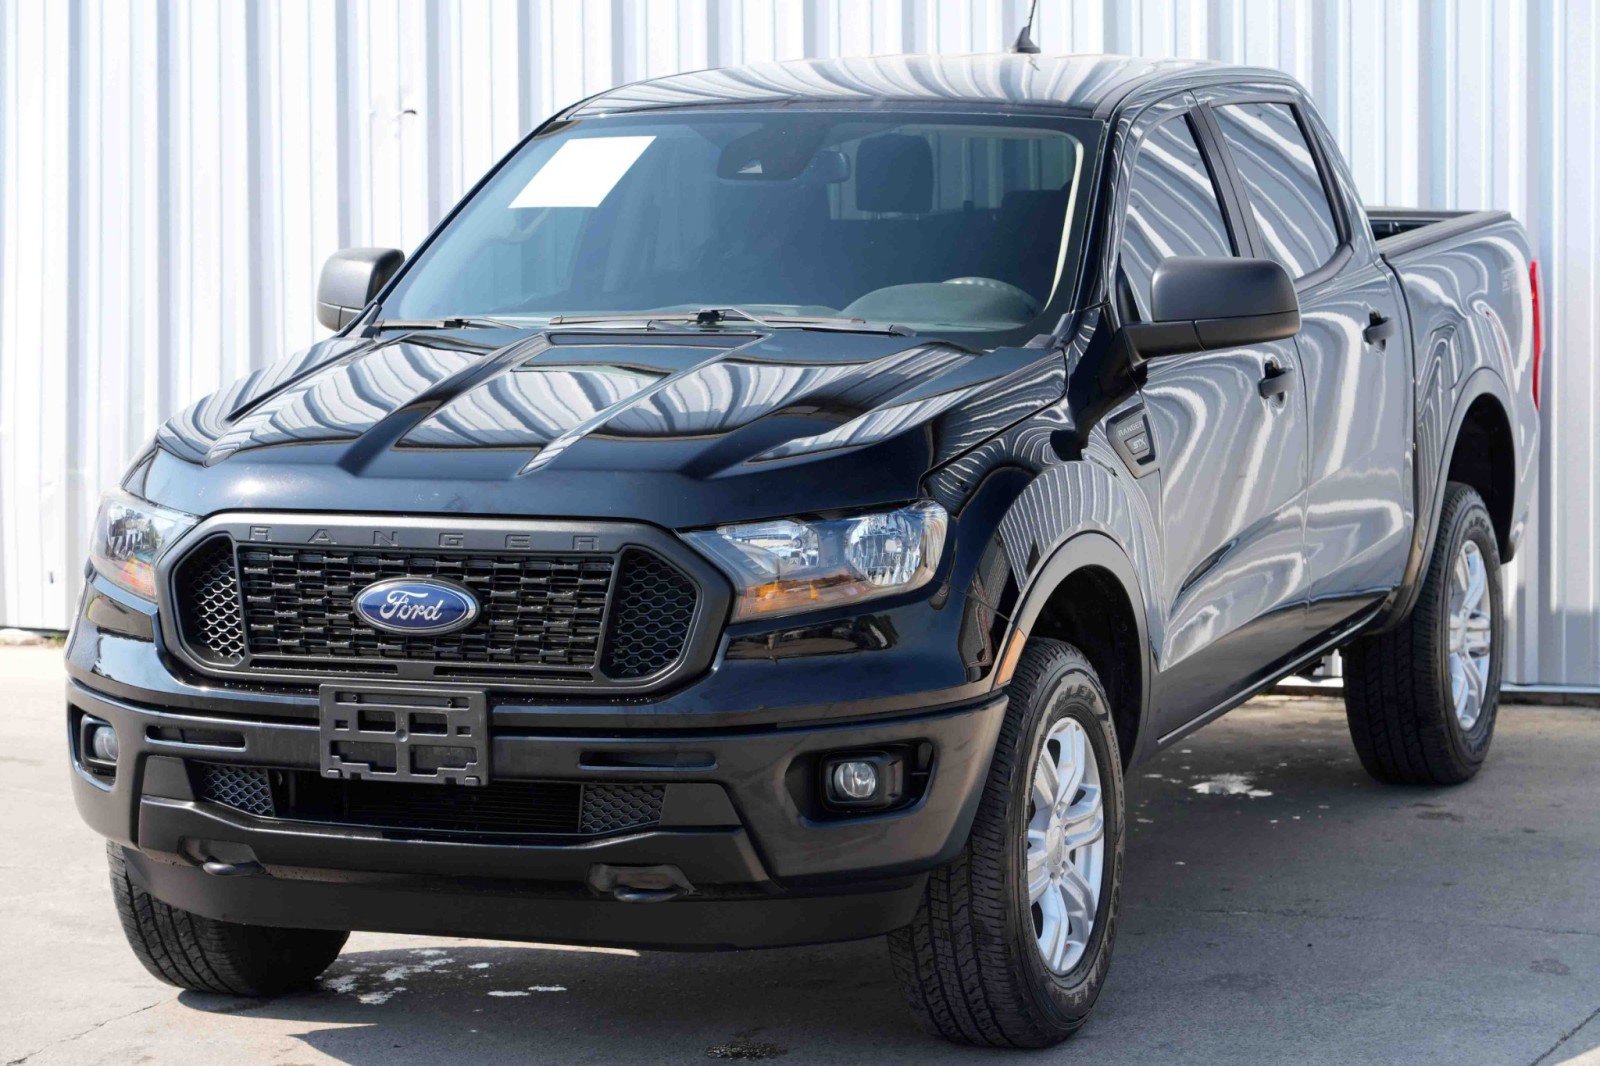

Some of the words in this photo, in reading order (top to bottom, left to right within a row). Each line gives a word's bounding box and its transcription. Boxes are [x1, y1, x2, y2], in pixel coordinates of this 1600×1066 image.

[1117, 420, 1144, 438] RANGER
[1133, 438, 1147, 449] STX
[249, 525, 600, 551] RANGER
[380, 590, 444, 621] Ford
